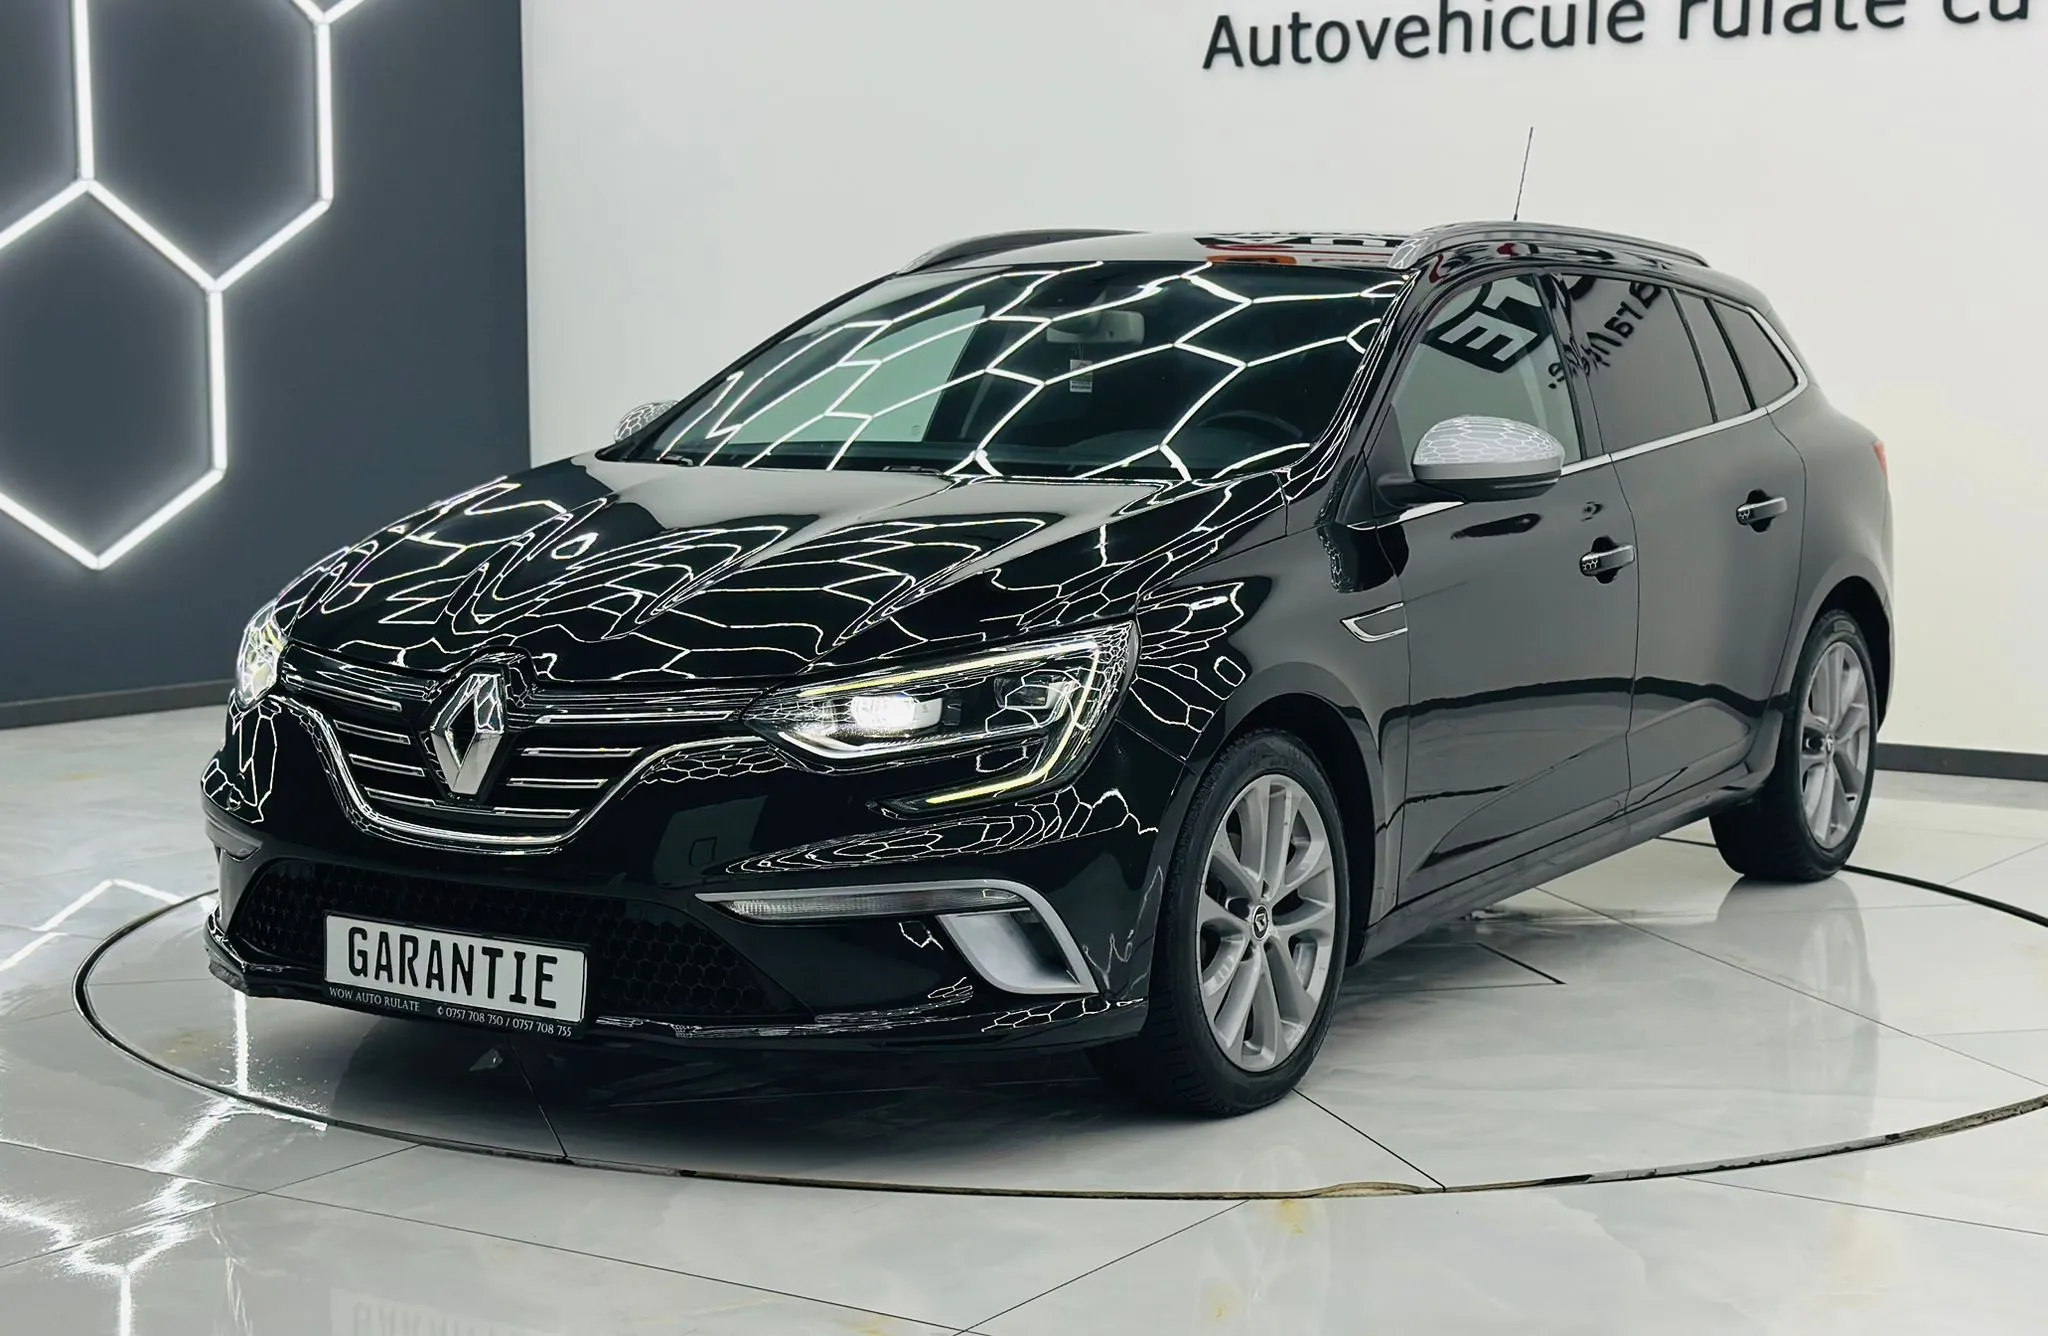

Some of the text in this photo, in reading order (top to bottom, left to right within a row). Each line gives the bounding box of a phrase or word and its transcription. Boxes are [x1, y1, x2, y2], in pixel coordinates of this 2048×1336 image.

[1202, 0, 1645, 70] Autovehicule
[1678, 0, 1906, 40] rulate
[348, 926, 558, 1009] GARANTIE
[329, 986, 353, 1000] WOW
[355, 992, 382, 1005] AUTO
[384, 996, 420, 1012] RULATE
[445, 1007, 466, 1020] 0757
[468, 1010, 485, 1023] 708
[487, 1013, 504, 1026] 750
[512, 1018, 534, 1031] 0757
[536, 1021, 554, 1035] 708
[557, 1025, 572, 1037] 755
